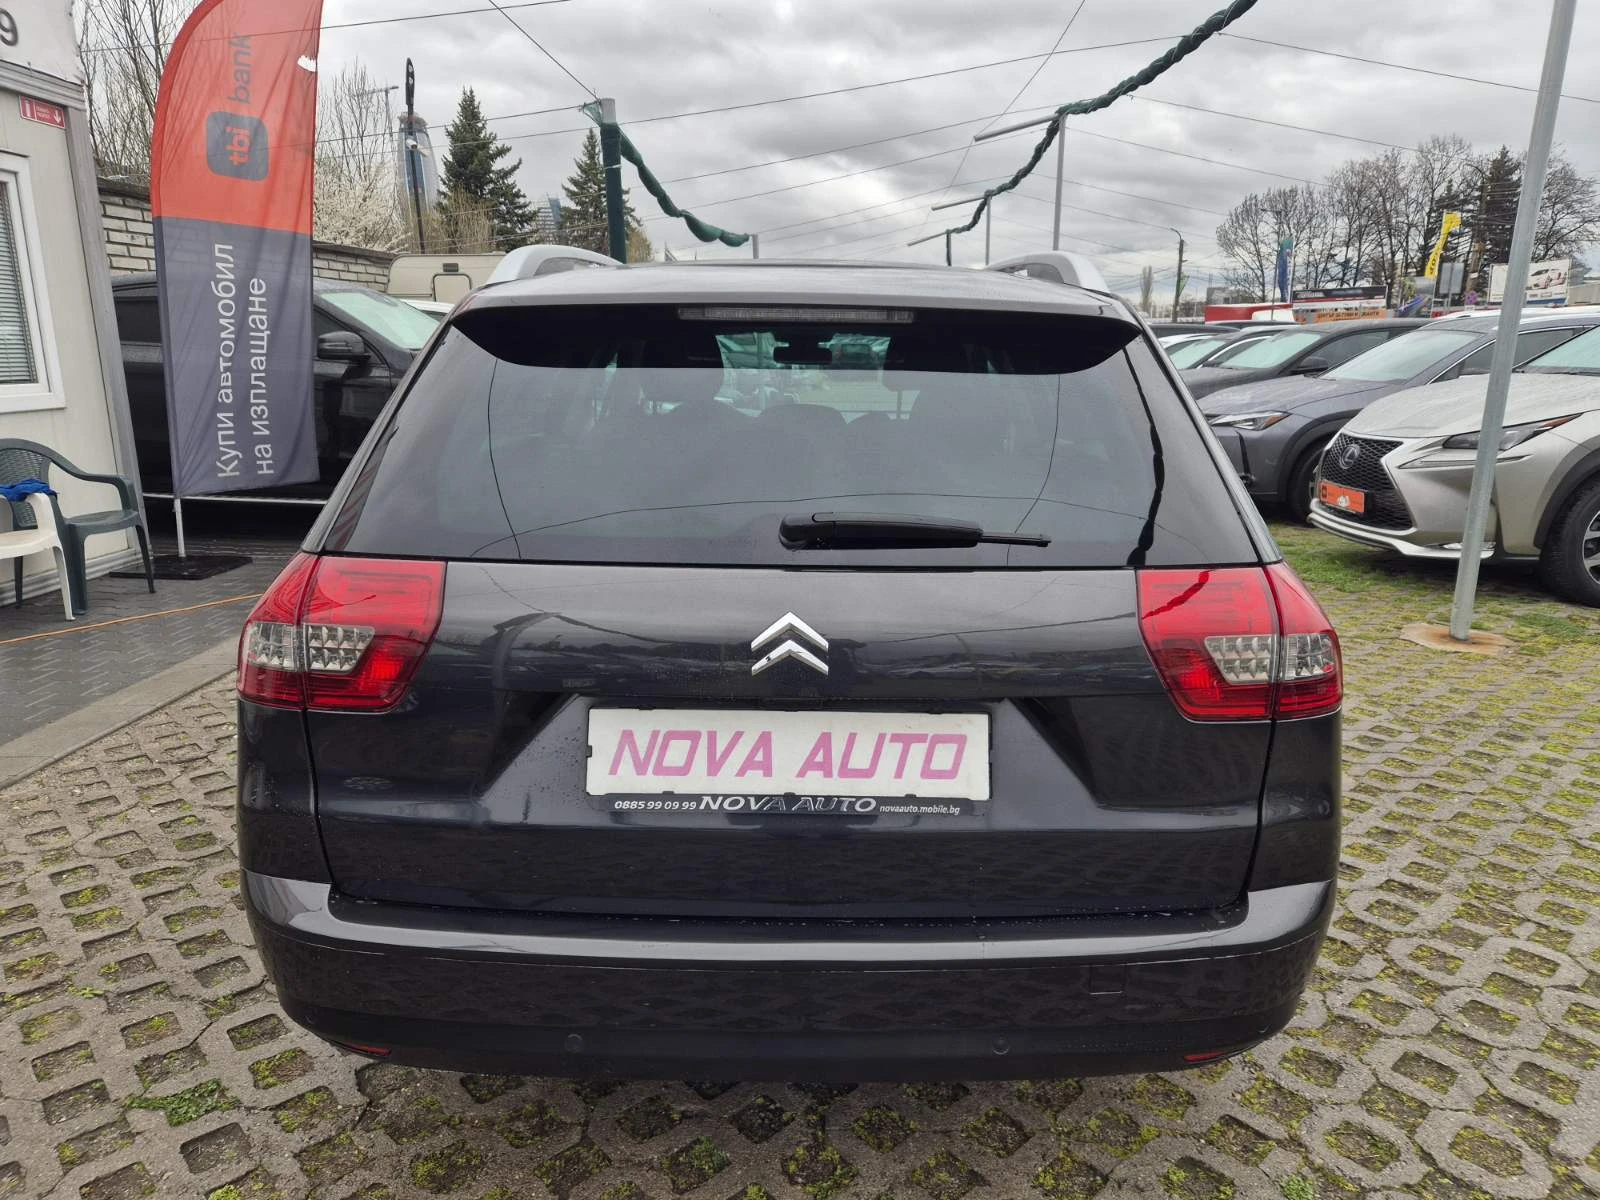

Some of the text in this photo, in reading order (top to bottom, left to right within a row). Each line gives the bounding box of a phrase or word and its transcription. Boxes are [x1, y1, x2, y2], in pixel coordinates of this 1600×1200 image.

[225, 33, 251, 165] tbi bank
[211, 243, 242, 477] Купи автомобил
[247, 278, 274, 475] на изплащане
[608, 729, 968, 780] NOVA AUTO
[614, 796, 961, 815] 0885 99 09 99 NOVA AUTO novaauto.mobile.bg
